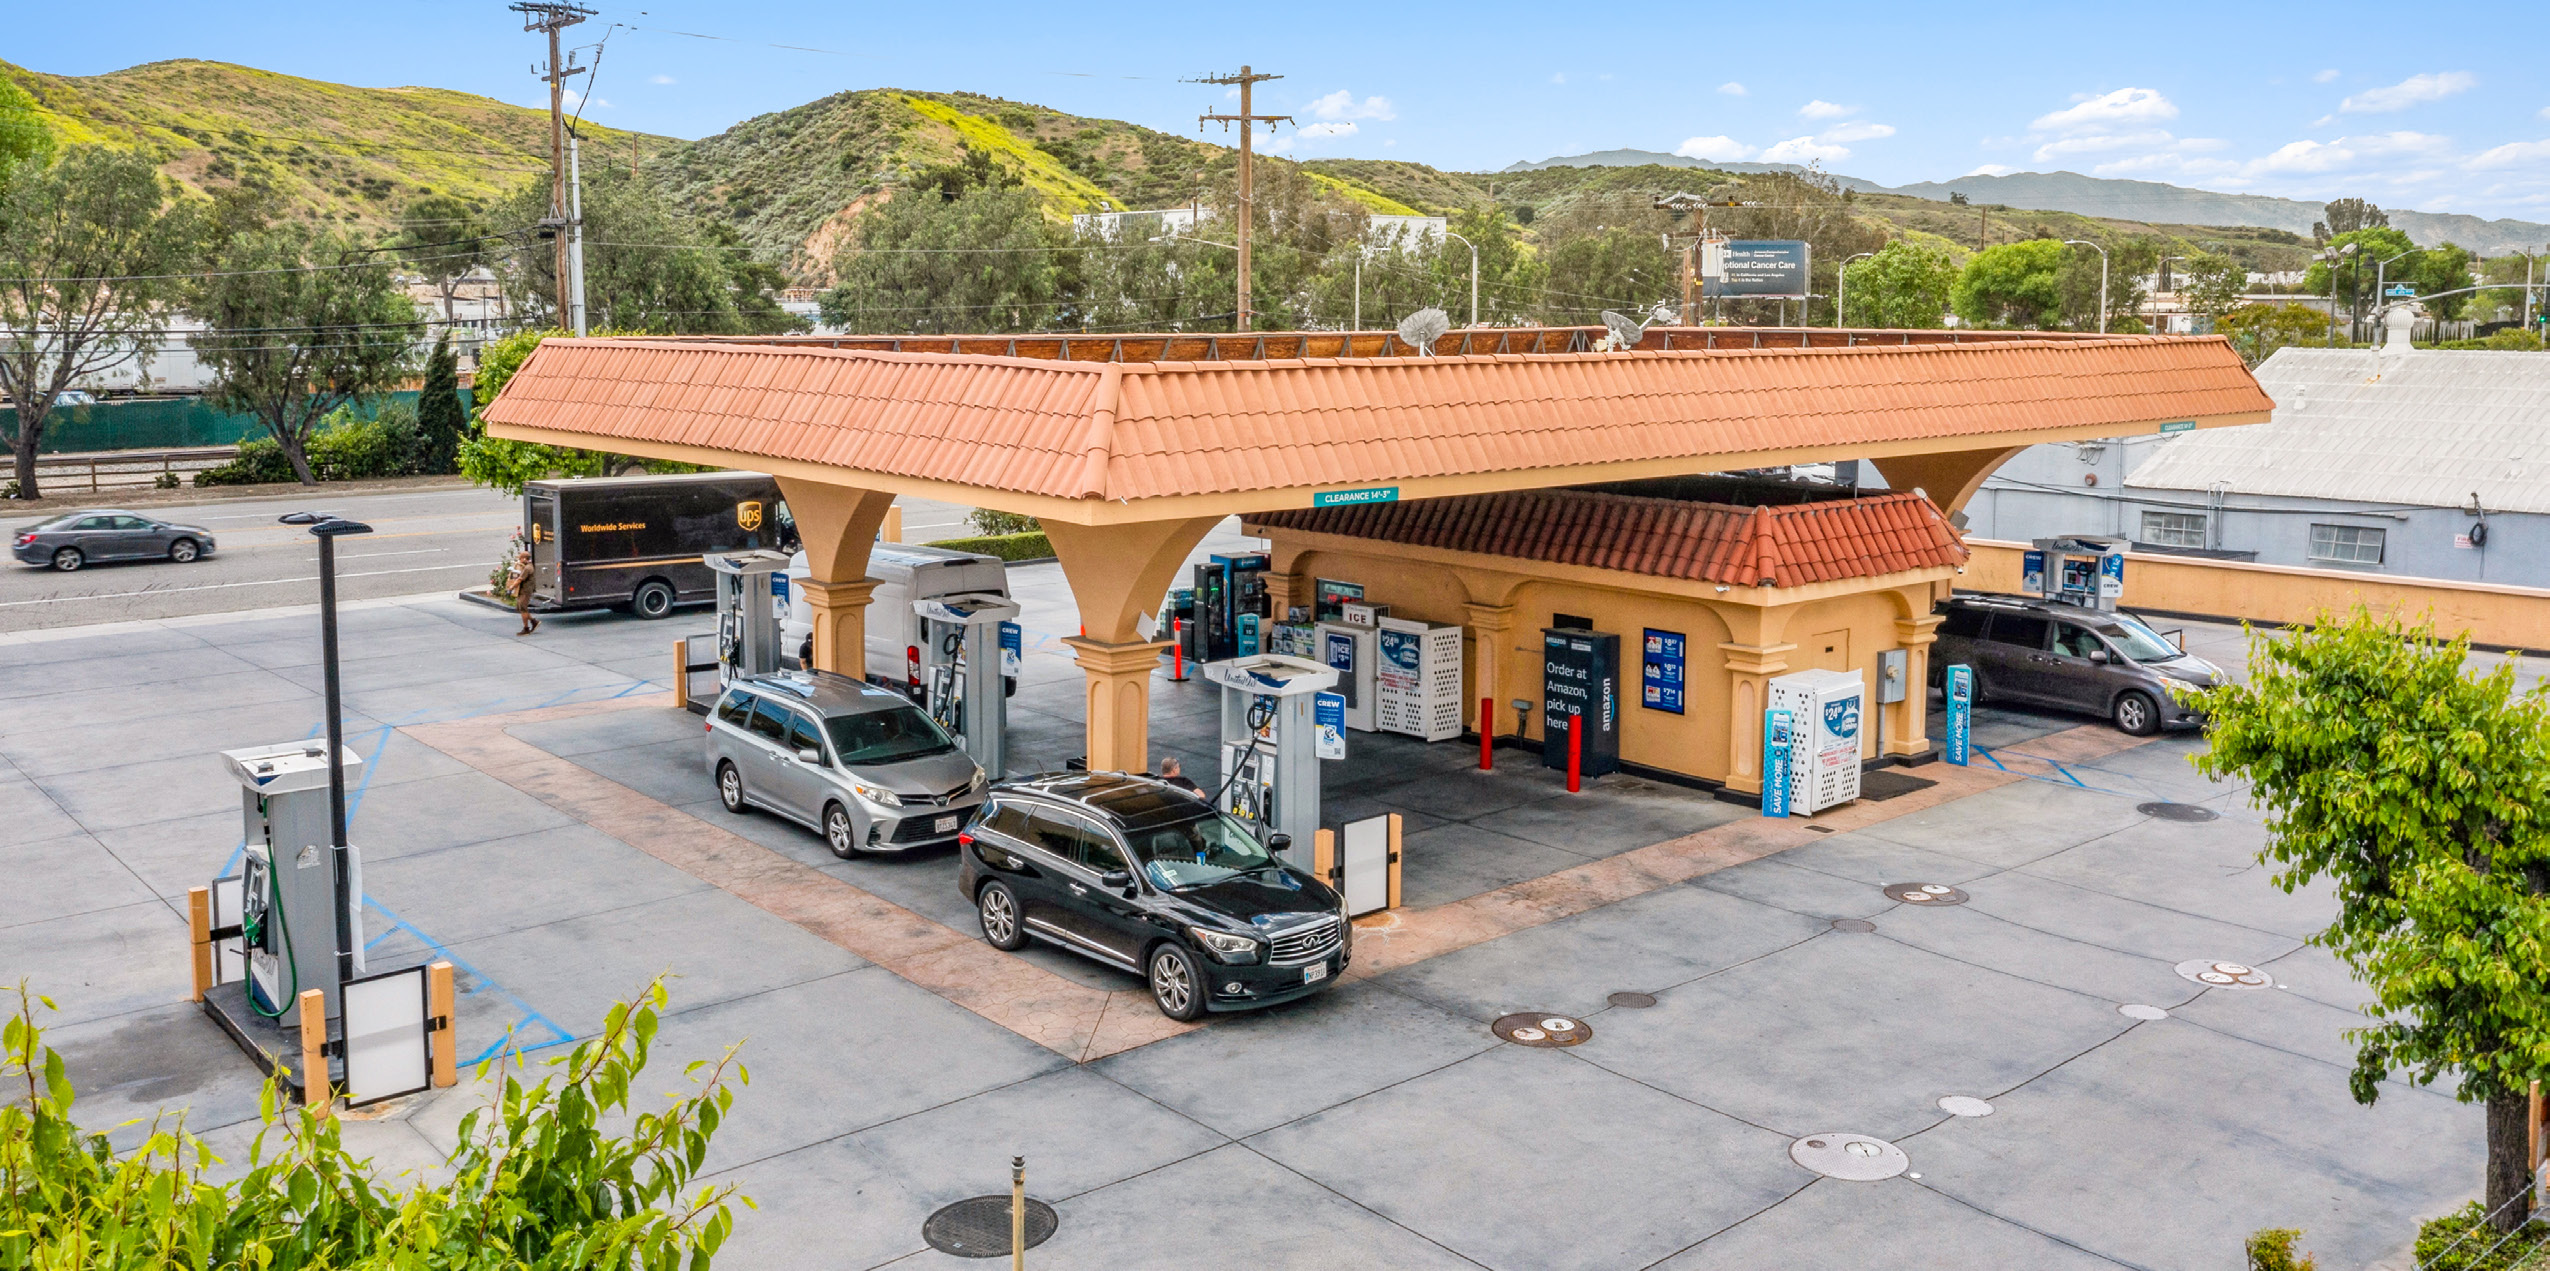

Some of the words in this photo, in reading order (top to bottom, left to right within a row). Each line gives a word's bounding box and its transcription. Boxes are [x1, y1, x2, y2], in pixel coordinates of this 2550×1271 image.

[1723, 261, 1750, 270] ptional
[1751, 261, 1777, 269] Cancer
[1778, 261, 1796, 269] Care
[1324, 492, 1370, 503] CLEARANCE
[740, 509, 760, 526] ups
[580, 523, 617, 533] Worldwide
[618, 522, 646, 531] Services
[1349, 613, 1367, 624] ICE
[1002, 627, 1019, 635] CREW
[1338, 645, 1350, 654] ICE
[1546, 661, 1575, 677] Order
[1576, 668, 1588, 680] at
[1546, 680, 1588, 700] Amazon,
[1317, 700, 1340, 708] CREW
[1546, 698, 1567, 712] pick
[1568, 703, 1581, 715] up
[1602, 677, 1611, 732] amazon
[1546, 714, 1569, 730] here
[1955, 711, 1964, 738] MORE
[1955, 738, 1963, 762] SAVE
[1774, 758, 1784, 788] MORE
[1773, 788, 1783, 814] SAVE
